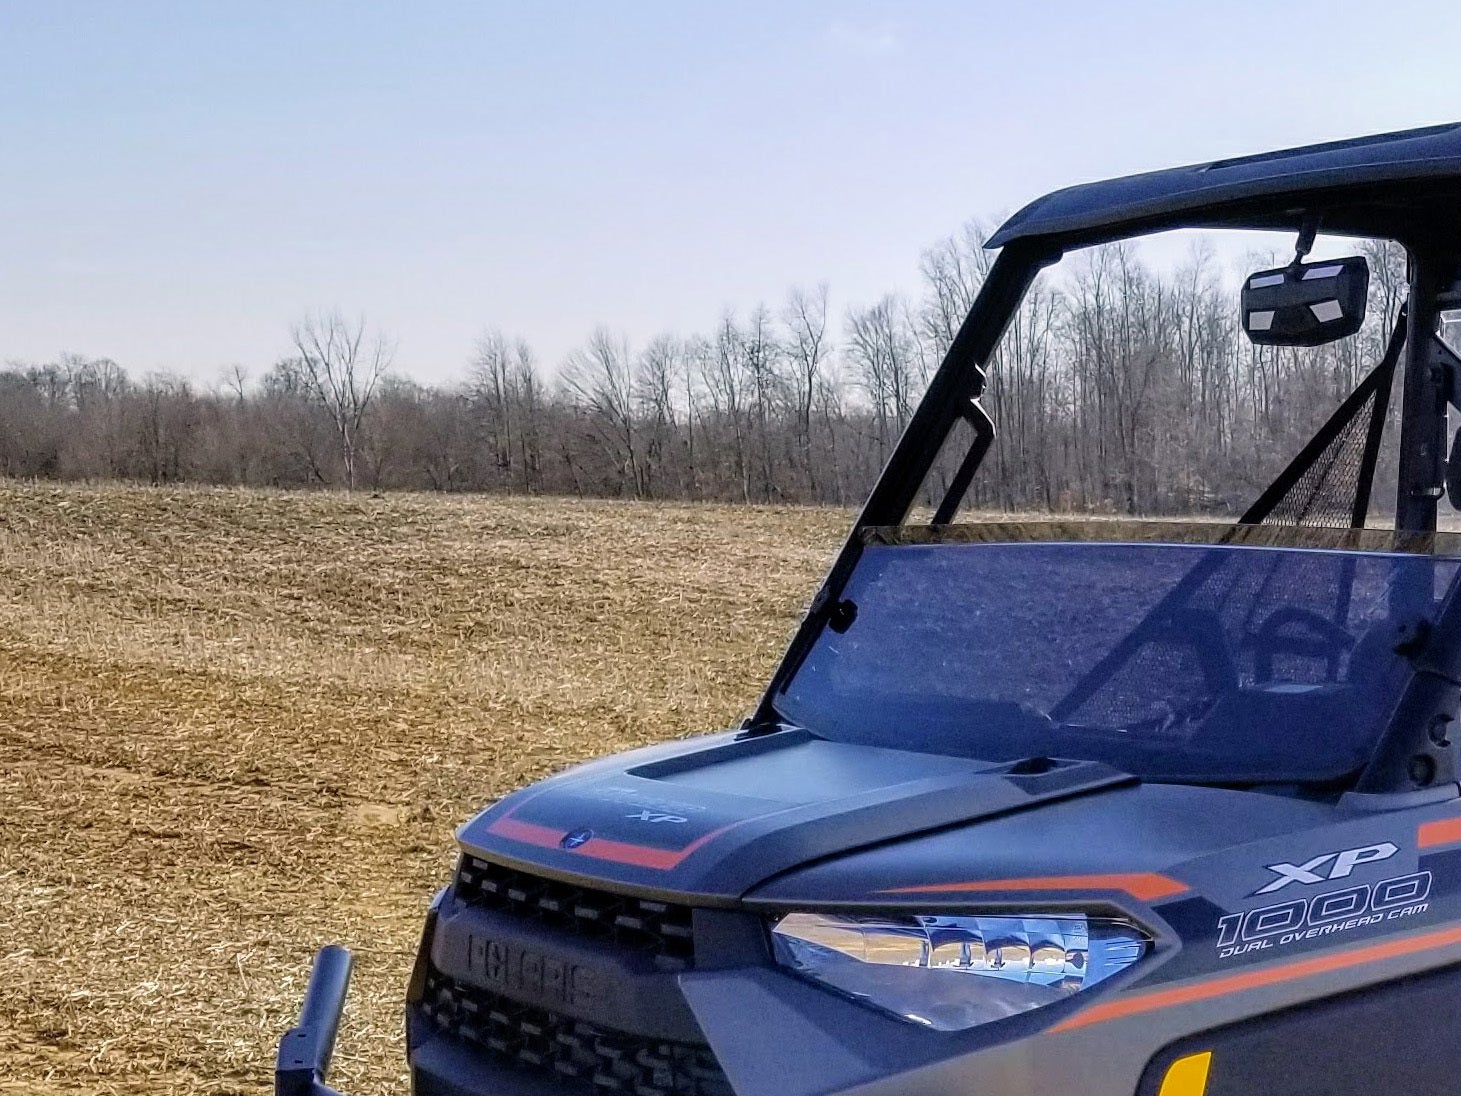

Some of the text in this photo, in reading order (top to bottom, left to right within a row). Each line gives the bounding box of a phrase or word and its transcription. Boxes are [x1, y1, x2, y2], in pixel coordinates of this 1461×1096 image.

[623, 810, 689, 823] XP
[1249, 841, 1400, 896] XP
[1216, 870, 1433, 948] 1000
[1219, 902, 1430, 959] DUAL OVERHEAD CAM
